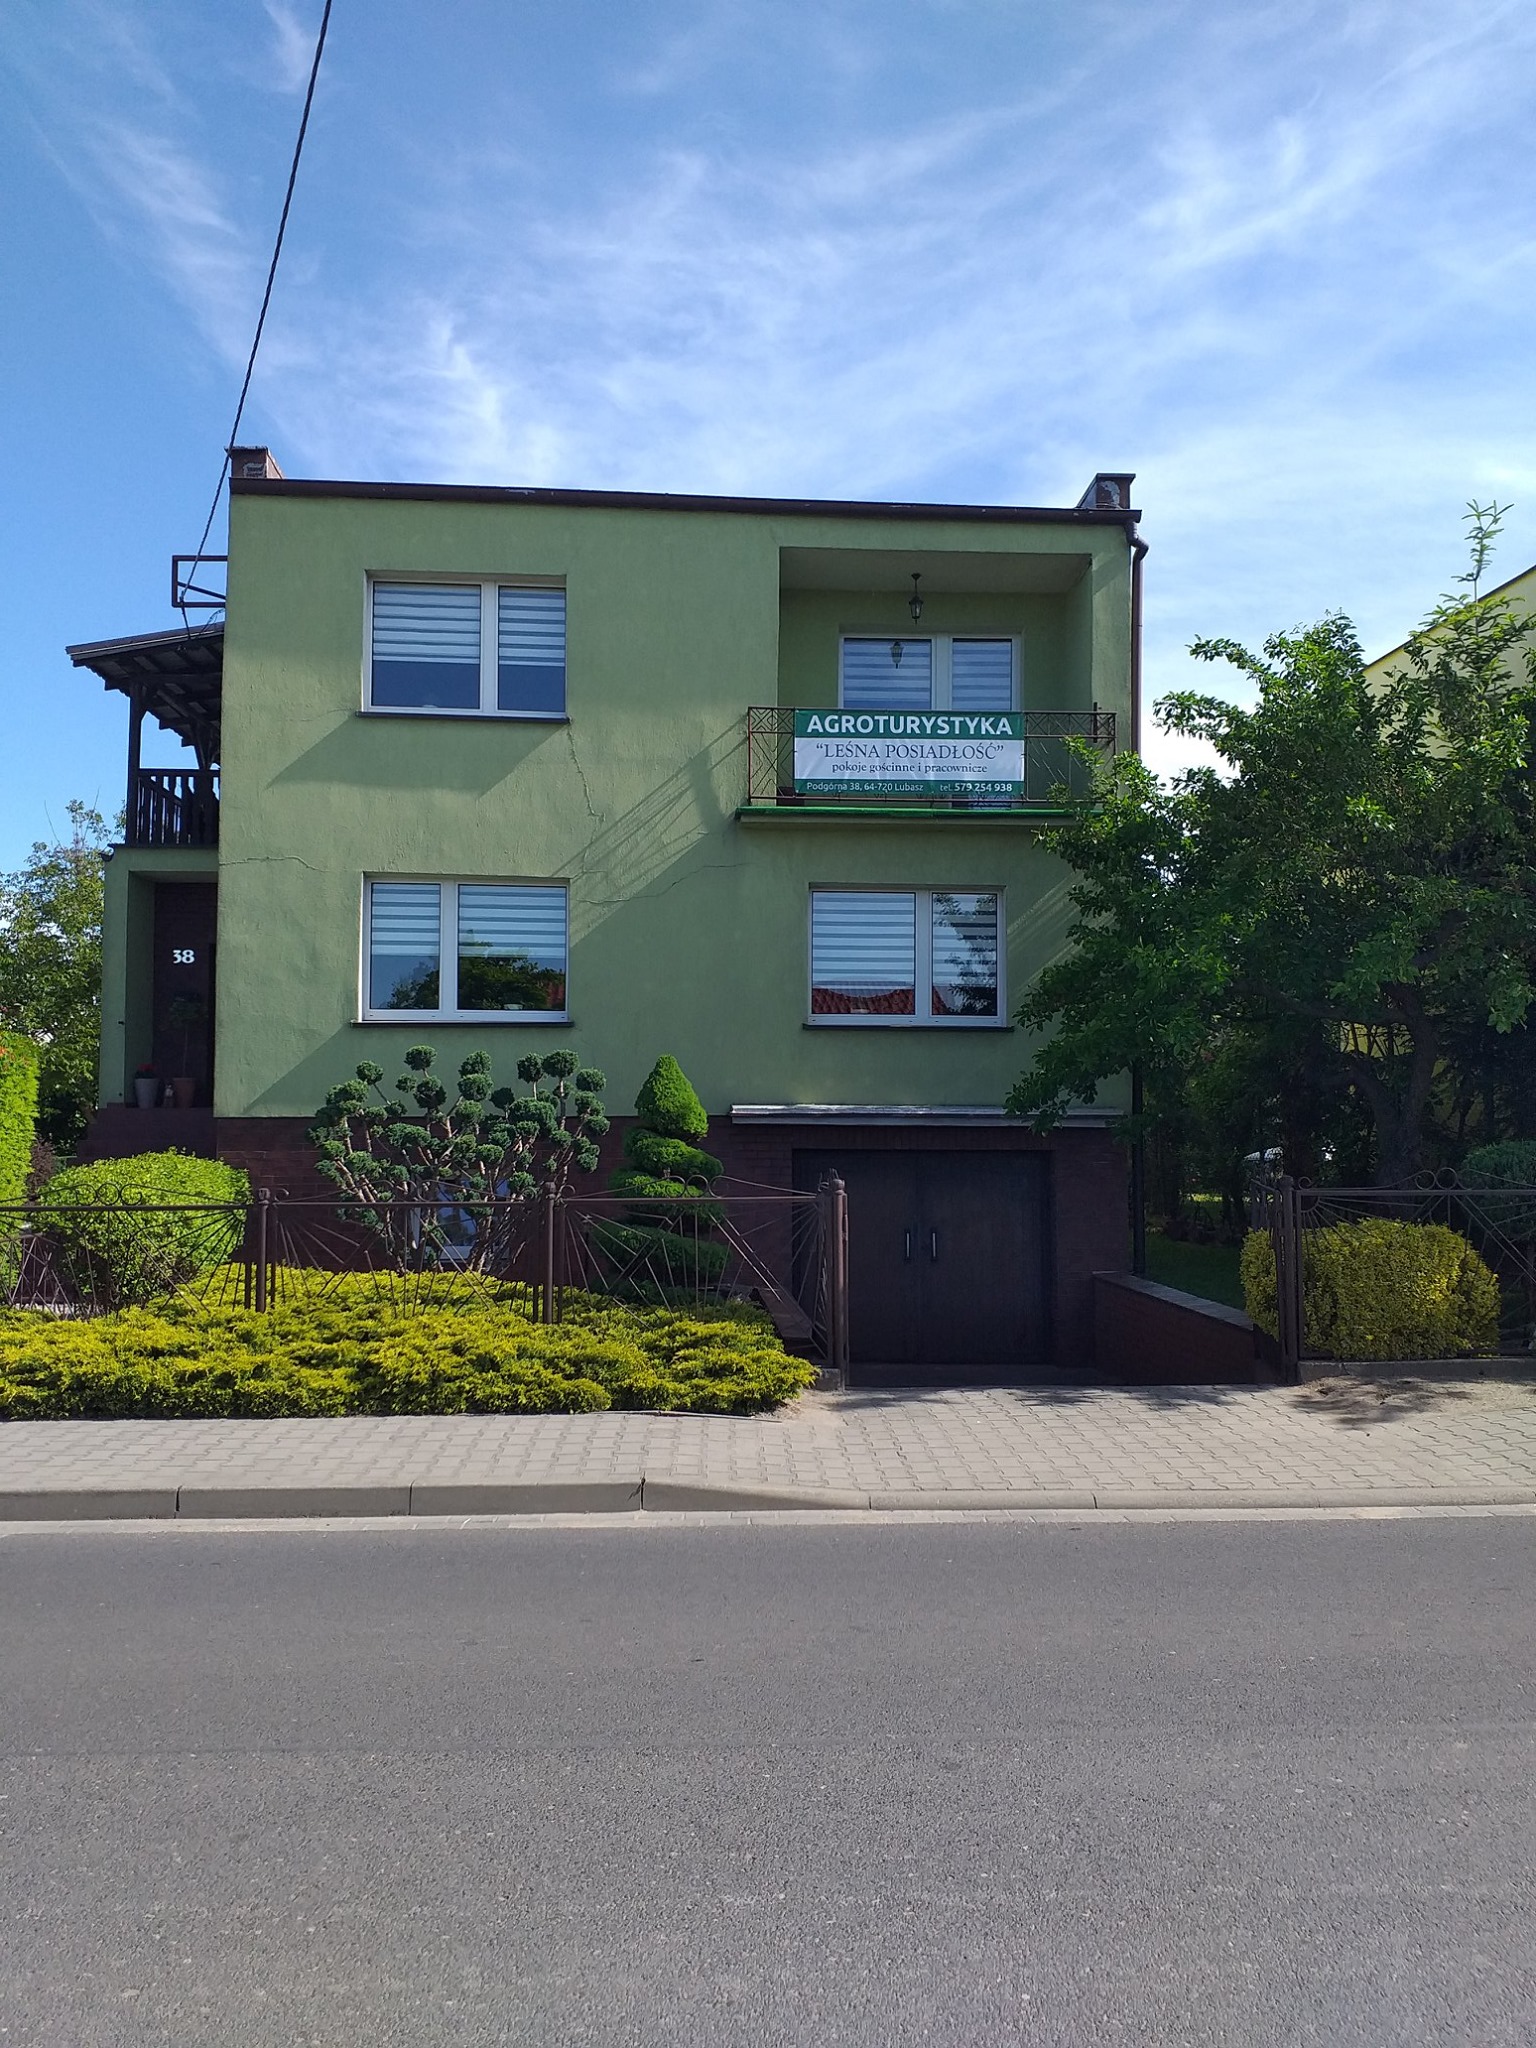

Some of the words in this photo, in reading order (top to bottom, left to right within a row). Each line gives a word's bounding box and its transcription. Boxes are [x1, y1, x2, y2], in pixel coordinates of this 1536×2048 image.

[806, 714, 1013, 735] AGROTURYSTYKA
[832, 761, 867, 773] pokoje
[869, 762, 915, 773] gościnne
[918, 762, 921, 772] i
[924, 763, 988, 774] pracownicze
[806, 782, 848, 792] Podgórna
[849, 782, 862, 792] 38,
[864, 782, 893, 792] 64-720
[895, 782, 924, 792] Lubasz
[954, 783, 972, 792] 579
[974, 783, 992, 792] 254
[994, 783, 1013, 792] 938
[172, 949, 195, 964] 38
